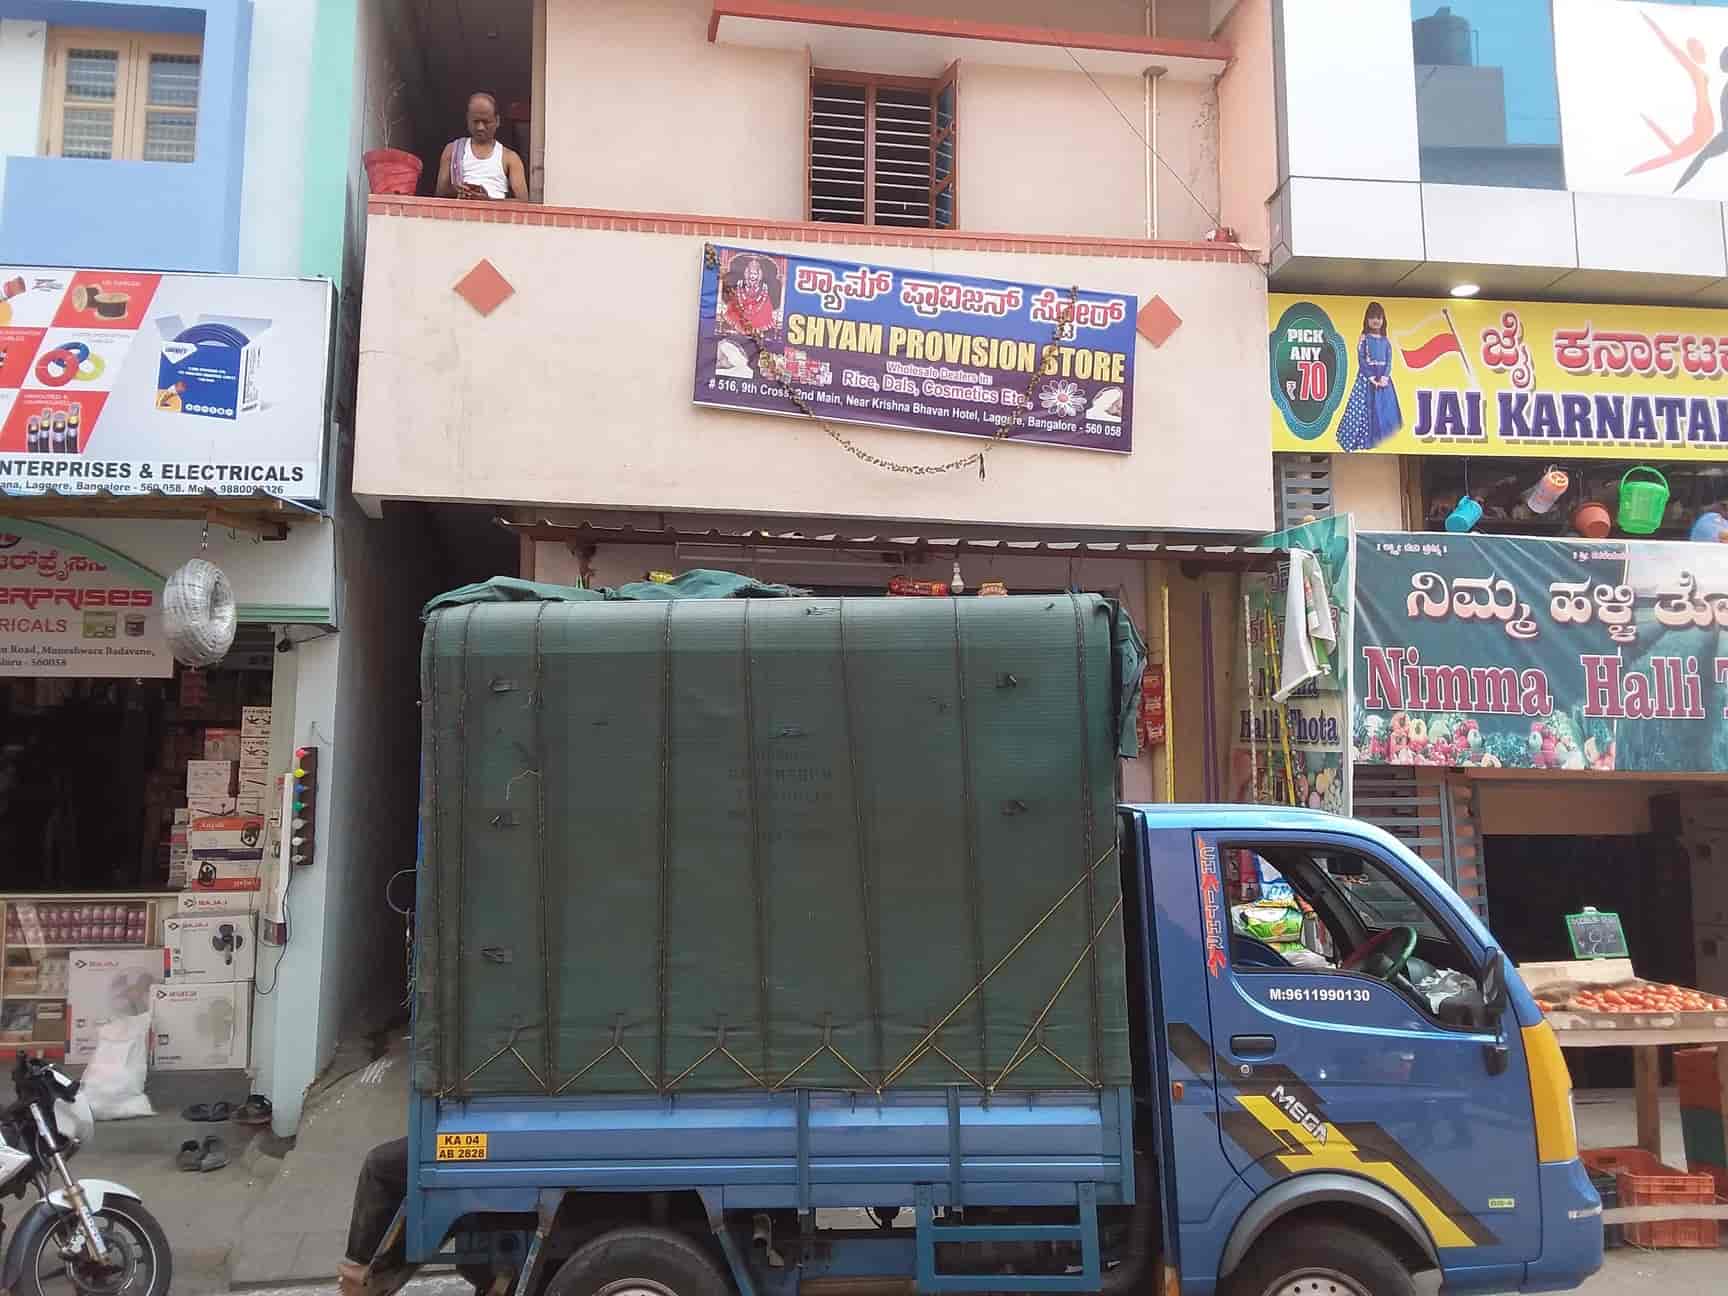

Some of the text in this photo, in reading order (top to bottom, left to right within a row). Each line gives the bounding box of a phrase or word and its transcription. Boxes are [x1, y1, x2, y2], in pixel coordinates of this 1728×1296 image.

[787, 313, 1126, 384] SHYAM PROVISION STORE
[1287, 328, 1324, 343] PICK
[1290, 346, 1321, 360] ANY
[1481, 312, 1728, 389] ಜೈ ಕರ್ನಾಟ
[842, 370, 880, 392] Rice,
[883, 375, 920, 396] Dals,
[922, 380, 1000, 404] Cosmetics
[887, 361, 938, 378] Wholesale
[940, 369, 979, 383] Dealers
[1297, 361, 1328, 401] 70
[718, 379, 739, 393] 516,
[742, 382, 757, 394] 9th
[760, 384, 793, 399] Cross,
[816, 391, 843, 405] Main,
[846, 394, 870, 407] Near
[872, 399, 910, 413] Krishna
[912, 402, 951, 418] Bhavan
[952, 406, 980, 422] Hotel,
[1028, 415, 1077, 433] Bangalore
[1085, 423, 1102, 435] 560
[1104, 425, 1122, 437] 058
[1413, 389, 1487, 438] JAI
[0, 460, 304, 481] NTERPRISES & ELECTRICALS
[1406, 571, 1539, 640] ನಿಮ್ಮ
[1363, 646, 1553, 716] Nimma
[1581, 654, 1705, 719] Halli
[1269, 988, 1371, 1001] M:9611990130
[1271, 1085, 1328, 1146] MEGA
[439, 1149, 454, 1158] AB
[445, 1135, 479, 1145] KA 04
